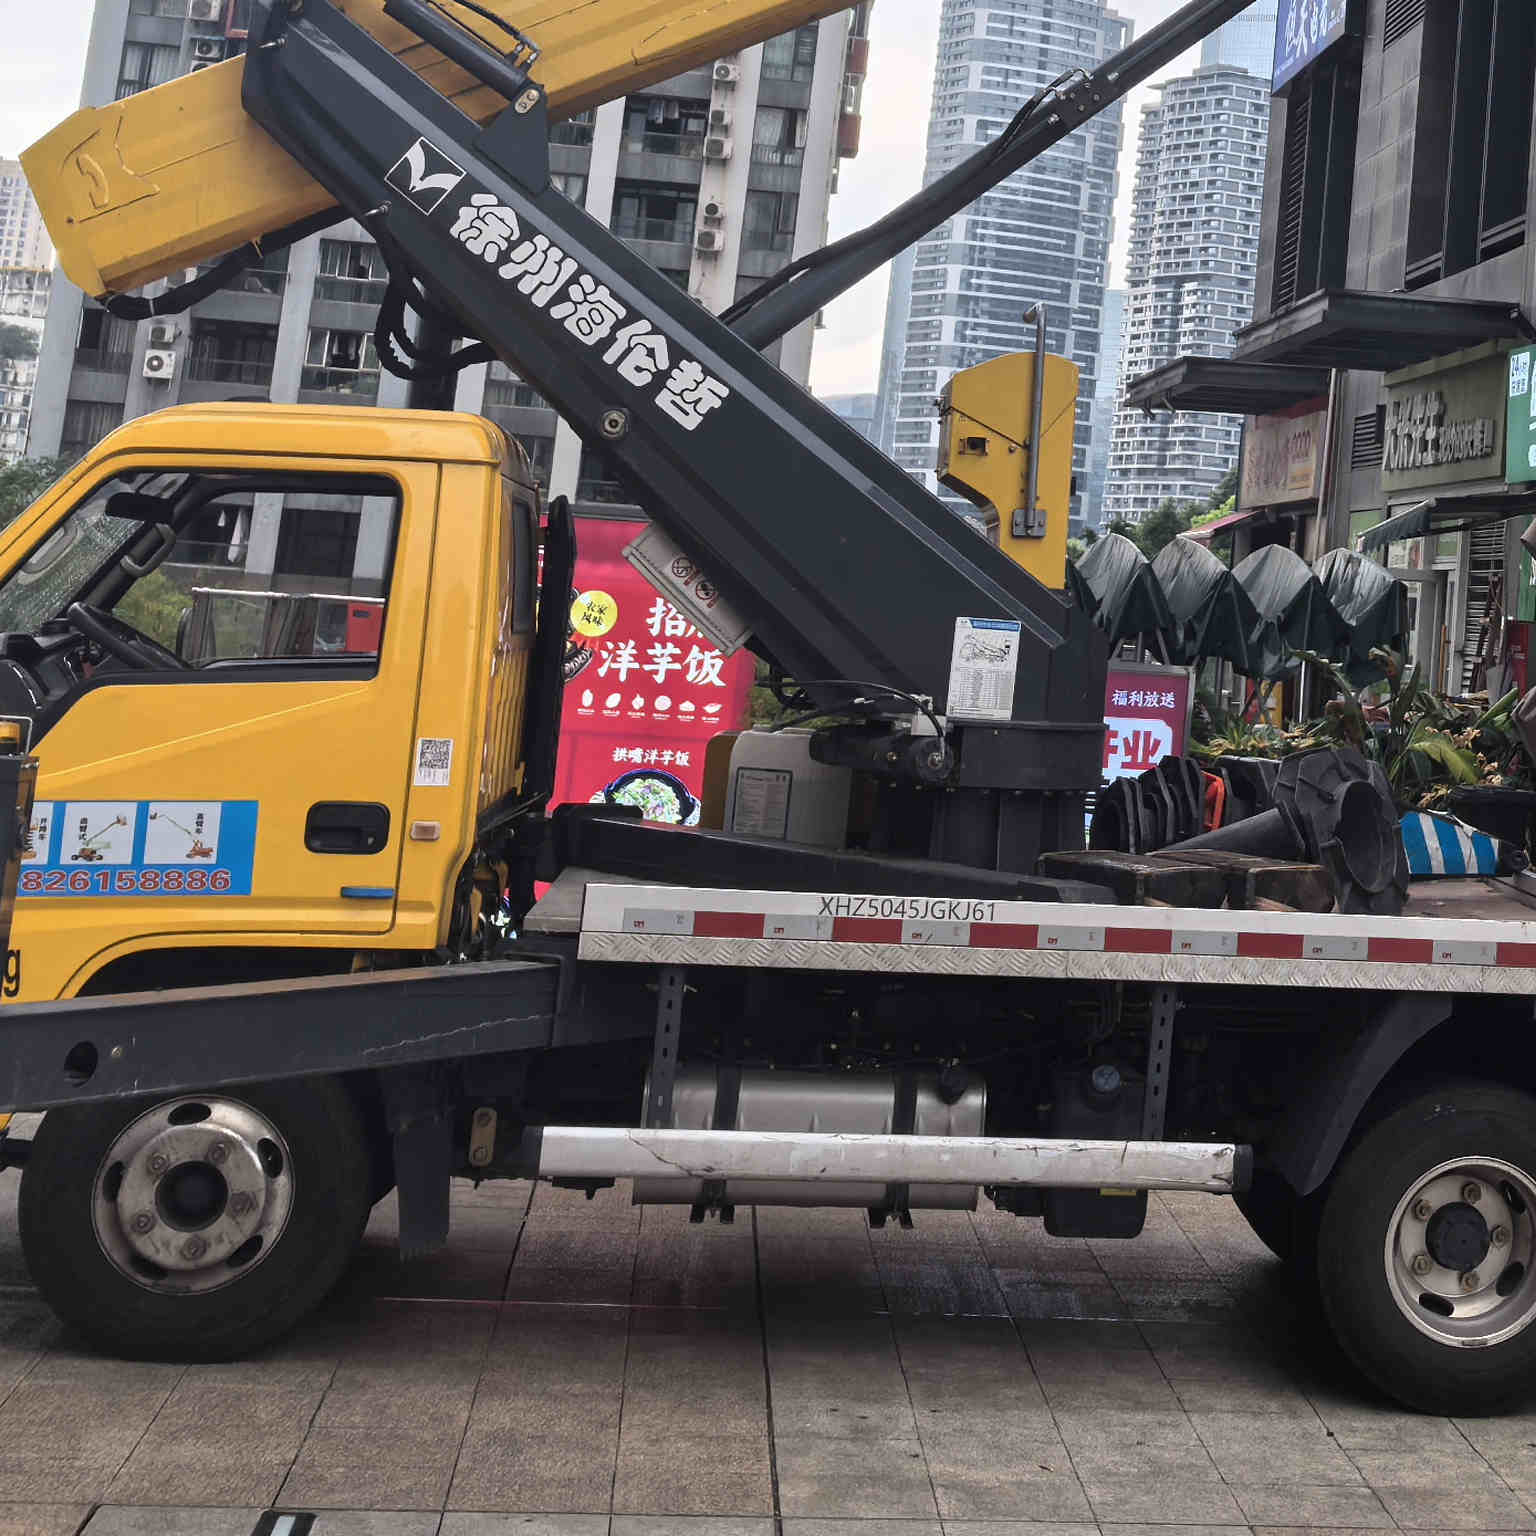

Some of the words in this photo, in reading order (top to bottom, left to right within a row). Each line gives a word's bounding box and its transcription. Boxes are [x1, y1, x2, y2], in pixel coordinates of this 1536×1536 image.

[448, 193, 729, 430] 徐州海伦哲
[646, 597, 704, 638] 招
[598, 640, 726, 687] 洋芋饭
[1111, 689, 1176, 708] 福利放送
[818, 896, 995, 922] XHZ5045JGKJ61
